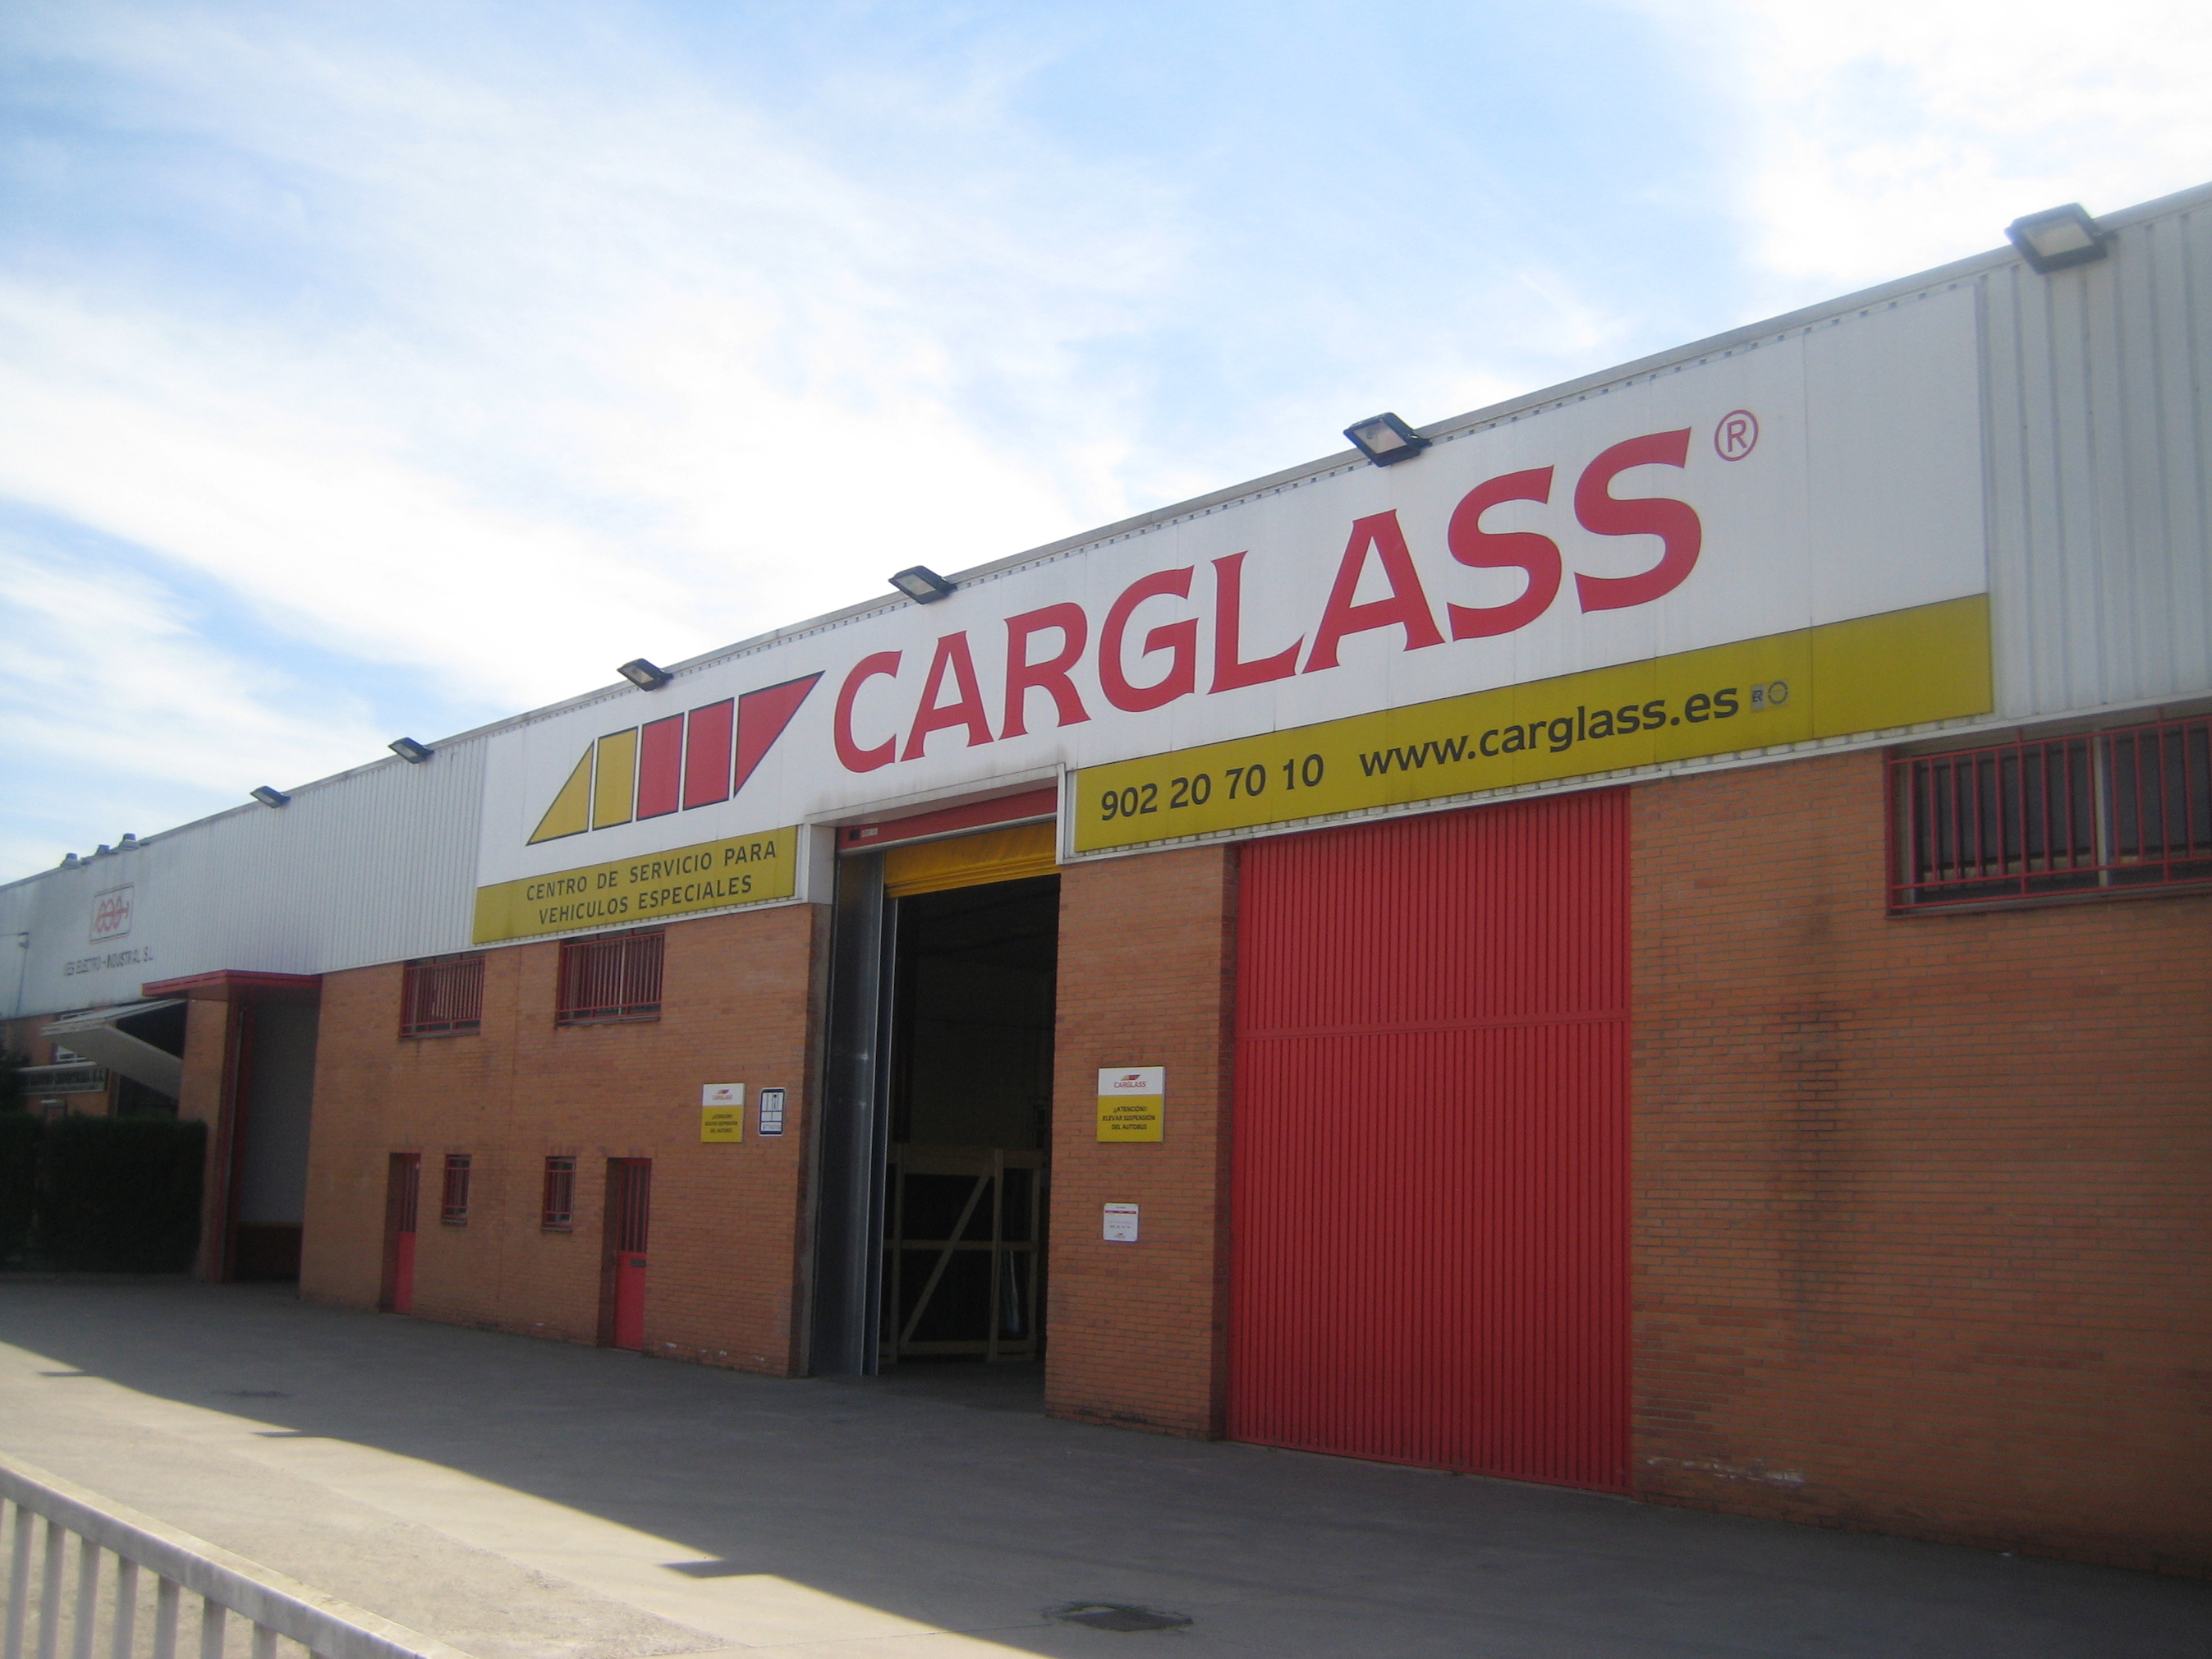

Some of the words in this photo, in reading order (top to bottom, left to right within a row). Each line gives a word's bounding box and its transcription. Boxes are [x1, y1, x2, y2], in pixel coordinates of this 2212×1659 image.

[834, 426, 1702, 773] CARGLASS
[1100, 783, 1159, 821] 902
[1169, 772, 1211, 810] 20
[1225, 763, 1266, 800] 70
[1283, 753, 1324, 791] 10
[1359, 687, 1740, 779] www.carglass.es
[526, 877, 588, 902] CENTRO
[597, 871, 618, 889] DE
[629, 852, 712, 884] SERVICIO
[723, 840, 777, 867] PARA
[539, 895, 629, 925] VEHICULOS
[638, 875, 753, 910] ESPECIALES
